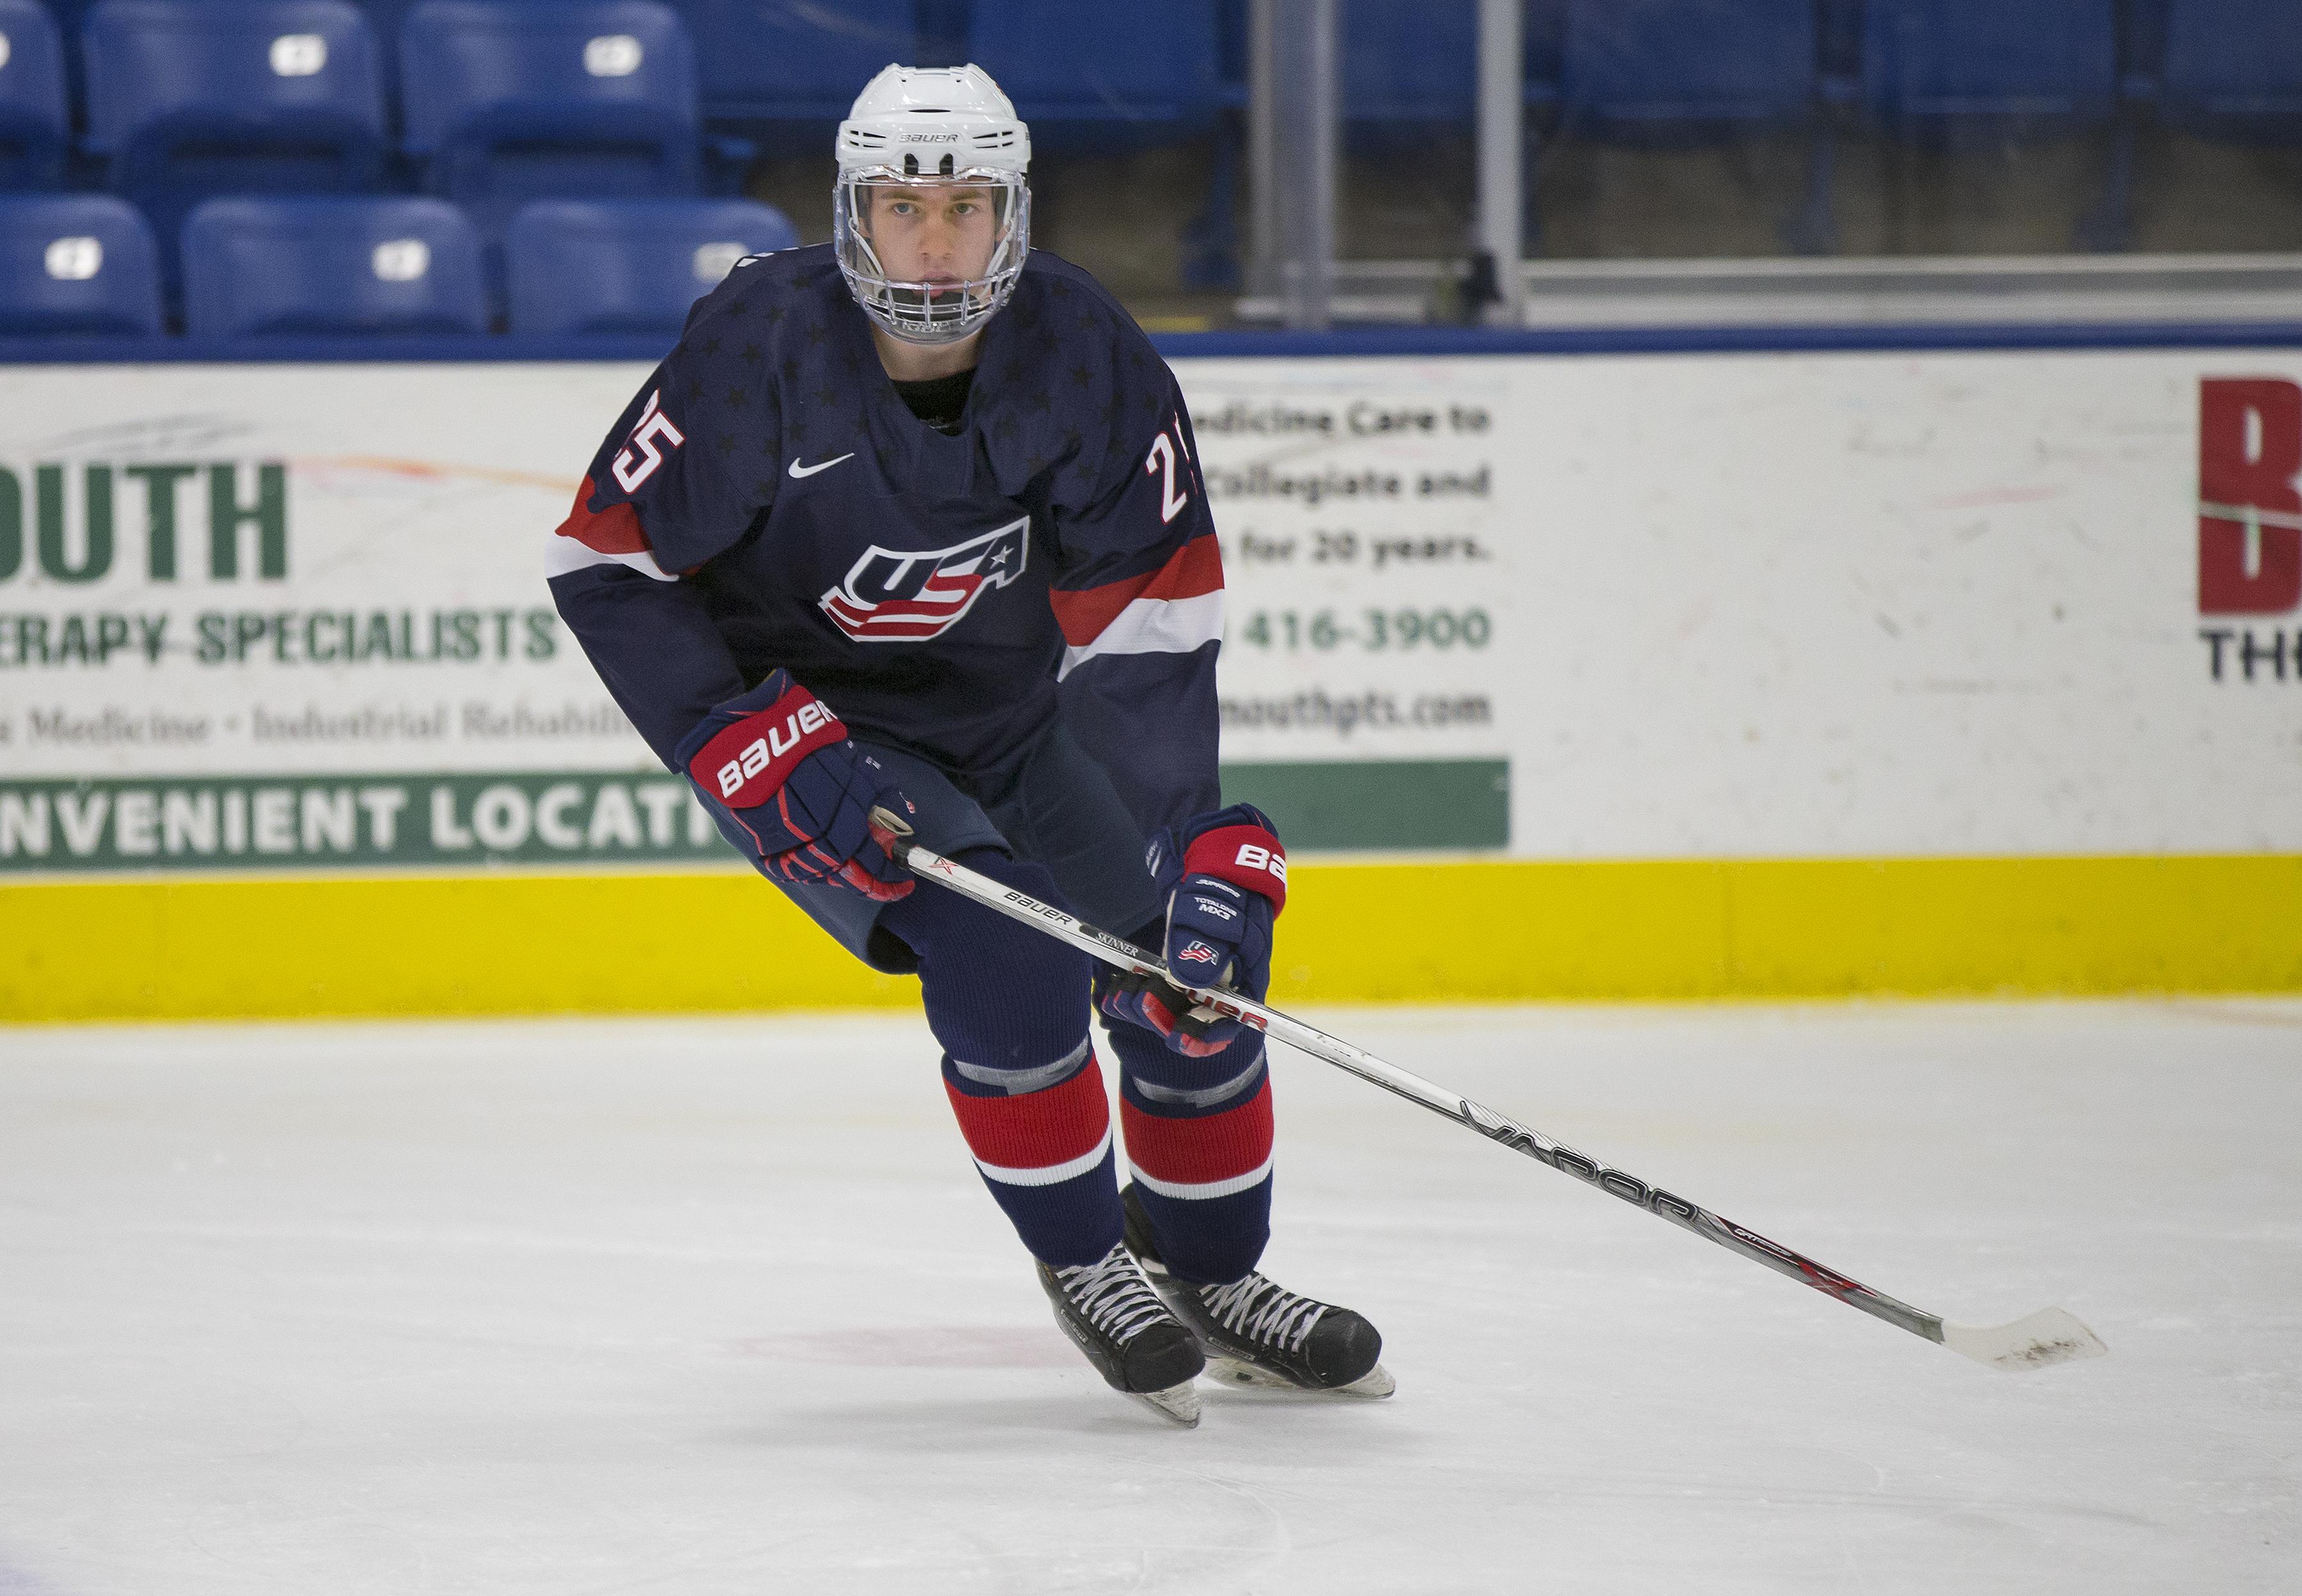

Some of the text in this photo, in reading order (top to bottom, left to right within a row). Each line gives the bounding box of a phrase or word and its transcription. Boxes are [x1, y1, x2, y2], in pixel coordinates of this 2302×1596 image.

[898, 132, 959, 143] BAUER
[1450, 401, 1492, 433] to
[1144, 409, 1199, 526] 2
[1417, 462, 1492, 498] and
[817, 515, 1030, 643] USA
[196, 608, 558, 667] SPECIALISTS
[1242, 608, 1492, 652] 416-3900
[2198, 629, 2302, 683] TH
[1003, 891, 1139, 957] BAUER SKINNER
[1198, 902, 1232, 921] MX3
